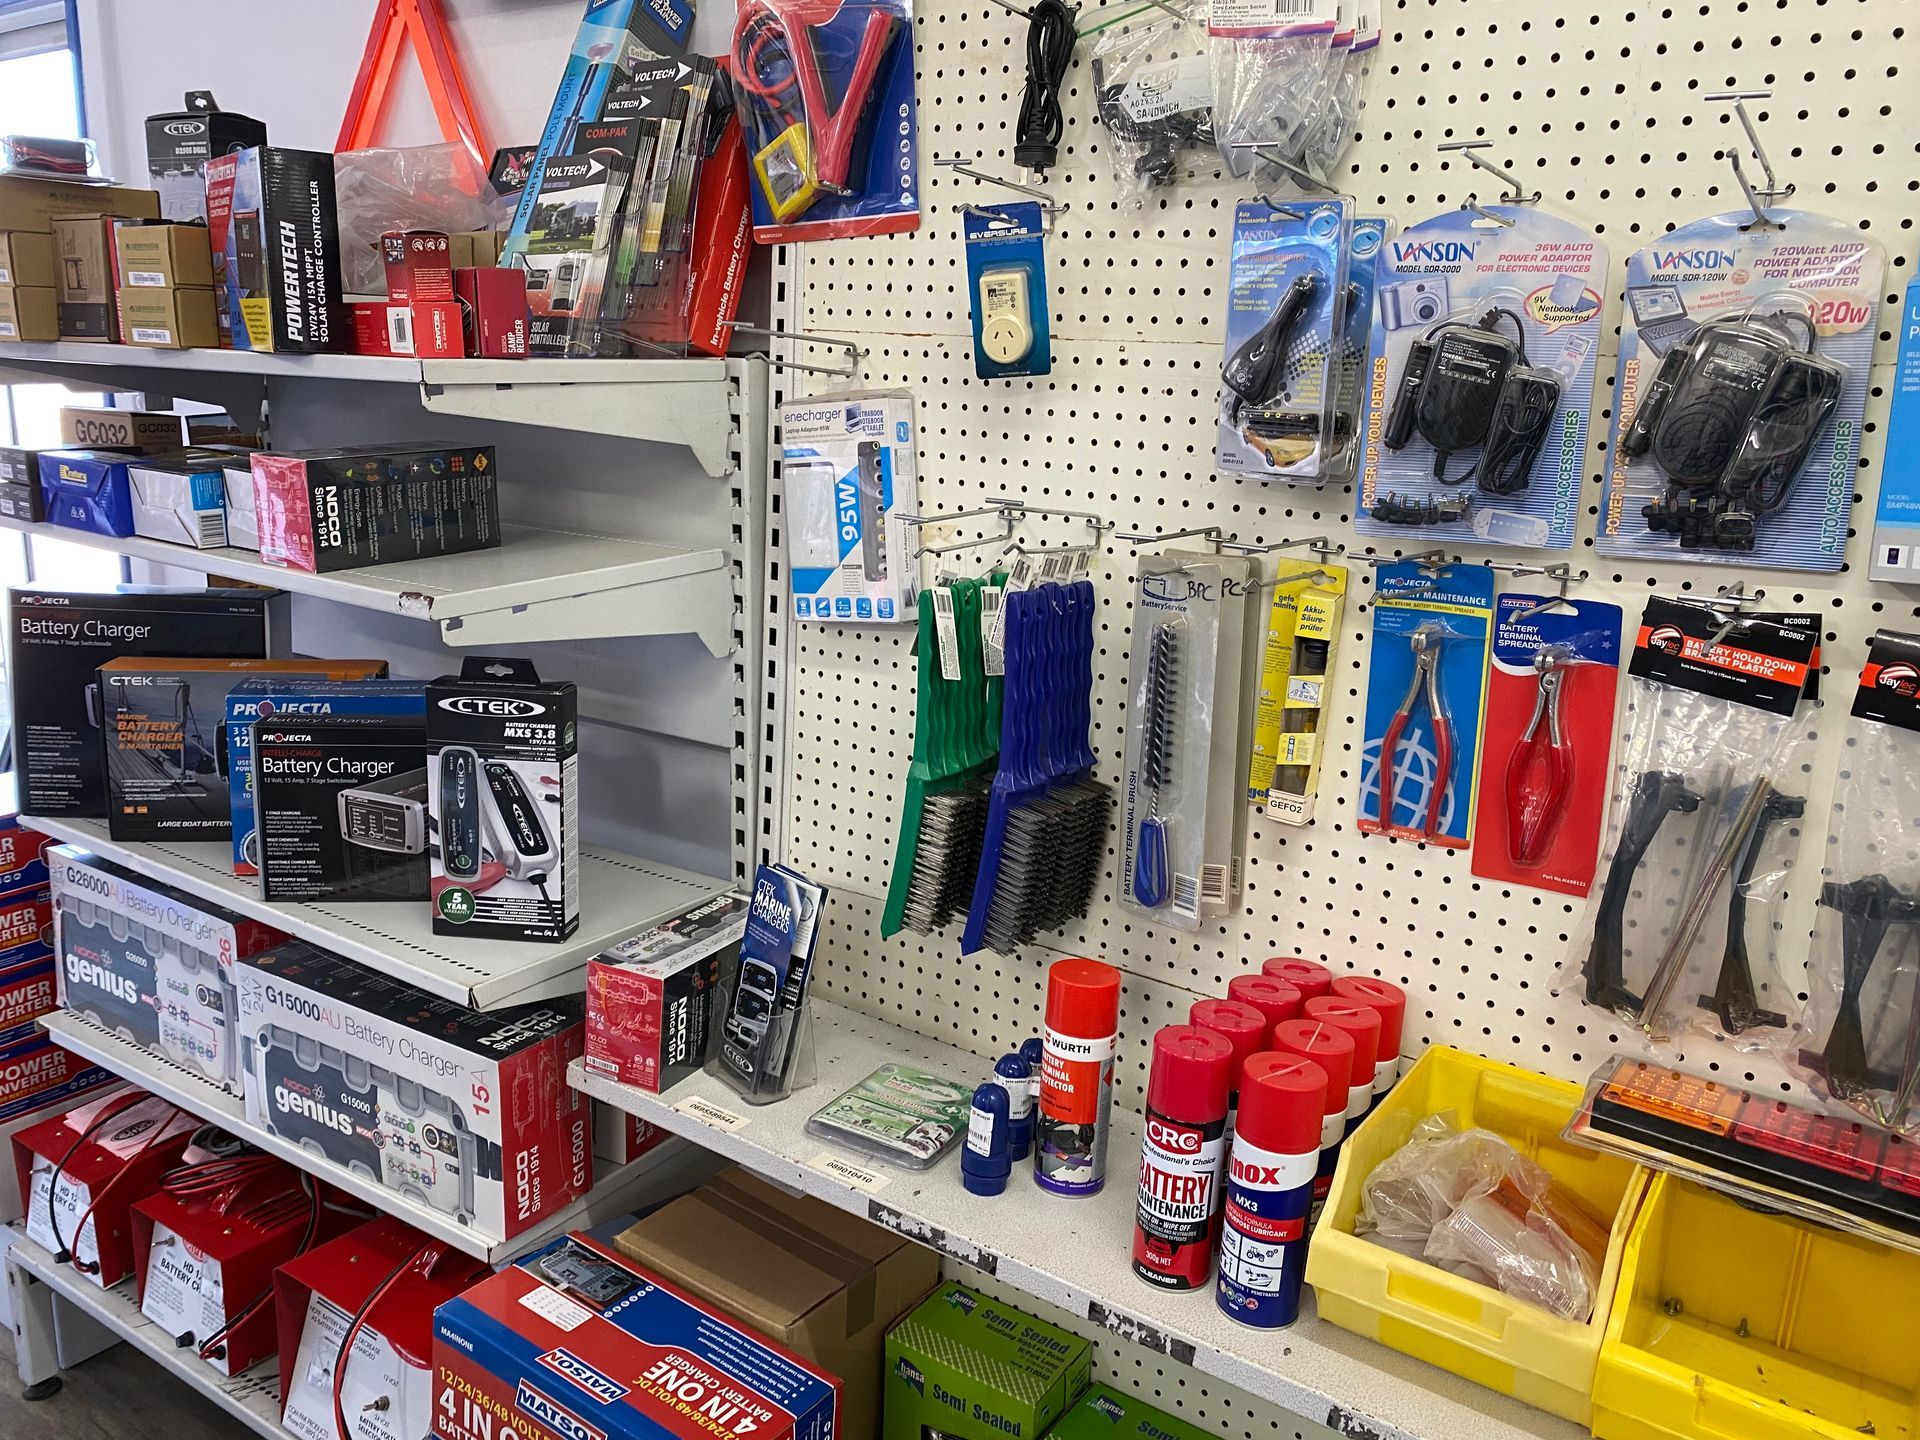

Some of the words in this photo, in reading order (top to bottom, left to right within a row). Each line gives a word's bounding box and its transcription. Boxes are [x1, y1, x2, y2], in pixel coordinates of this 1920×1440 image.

[634, 68, 675, 82] VOLTECH
[608, 100, 639, 110] VOLTECH
[1136, 101, 1180, 119] SANDWICH
[171, 123, 196, 134] CTEK
[586, 127, 627, 138] COM-PAK
[519, 177, 536, 220] SOLAR
[533, 146, 550, 180] PANEL
[548, 113, 561, 140] POLE
[558, 71, 577, 111] MOUNT
[546, 164, 587, 177] VOLTECH
[309, 180, 324, 256] CONTROLLER
[969, 227, 1028, 240] EVERSURE
[1393, 241, 1475, 263] VANSON
[1535, 244, 1562, 252] 36W
[1564, 243, 1594, 252] AUTO
[1772, 246, 1829, 257] 120Watt
[1830, 243, 1865, 255] AUTO
[303, 247, 314, 278] MPPT
[1499, 254, 1538, 263] POWER
[1541, 254, 1593, 263] ADAPTOR
[1653, 249, 1736, 270] VANSON
[1754, 257, 1801, 268] POWER
[709, 293, 728, 347] In-vehicle
[723, 250, 740, 290] Battery
[732, 205, 750, 250] Charger
[1395, 265, 1422, 273] MODEL
[1424, 265, 1462, 273] SDR-3000
[1476, 265, 1494, 273] FOR
[1496, 265, 1550, 273] ELECTRONIC
[1551, 265, 1591, 273] DEVICES
[1650, 274, 1680, 283] MODEL
[1682, 273, 1728, 282] SDR-120W
[1763, 269, 1788, 279] FOR
[279, 220, 304, 342] POWERTECH
[303, 279, 315, 300] 15A
[313, 257, 326, 304] CHARGE
[1788, 277, 1860, 289] COMPUTER
[1534, 295, 1546, 304] 9V
[1538, 304, 1575, 313] Netbook
[305, 301, 320, 341] 12V/24V
[318, 306, 329, 342] SOLAR
[530, 321, 550, 333] SOLAR
[1542, 313, 1591, 323] Supported
[516, 319, 525, 354] REDUCER
[1370, 357, 1388, 409] DEVICES
[784, 410, 842, 422] enecharger
[75, 418, 129, 446] GC032
[138, 423, 177, 433] GC032
[1367, 411, 1383, 447] YOUR
[1365, 445, 1380, 464] UP
[1556, 409, 1580, 498] ACCESSORIES
[1606, 490, 1626, 535] POWER
[1618, 358, 1641, 432] COMPUTER
[1826, 419, 1853, 514] ACCESSORIES
[1361, 466, 1378, 509] POWER
[314, 487, 325, 519] Since
[838, 483, 858, 541] 95W
[325, 485, 342, 547] NOCO
[1552, 497, 1570, 535] AUTO
[317, 520, 330, 547] 1914
[1820, 513, 1840, 554] AUTO
[1384, 578, 1431, 587] PROJECTA
[20, 596, 70, 605] PROJECTA
[1141, 600, 1187, 612] BatteryService
[1278, 595, 1295, 603] gefo
[1423, 591, 1487, 606] MAINTENANCE
[1502, 600, 1537, 608] MATSON
[1301, 613, 1326, 623] Säure-
[1303, 605, 1326, 614] Akku-
[20, 618, 79, 639] Battery
[84, 620, 150, 641] Charger
[1299, 623, 1324, 632] prüfer
[1499, 624, 1540, 633] BATTERY
[1784, 617, 1811, 625] BC0002
[1498, 632, 1543, 642] TERMINAL
[1650, 637, 1680, 651] Jaylec
[1779, 629, 1806, 641] BC0002
[1731, 659, 1775, 677] PLASTIC
[1733, 651, 1763, 665] HOLD
[1764, 658, 1796, 673] DOWN
[110, 676, 153, 686] CTEK
[1879, 673, 1917, 691] Jaylec
[457, 699, 521, 715] CTEK
[117, 722, 178, 731] BATTERY
[266, 716, 322, 725] Battery
[118, 732, 185, 742] CHARGER
[262, 733, 312, 742] PROJECTA
[503, 727, 532, 738] MXS
[534, 728, 556, 739] 3.8
[262, 758, 323, 777] Battery
[327, 758, 395, 777] Charger
[1128, 770, 1137, 804] BRUSH
[1126, 808, 1135, 854] TERMINAL
[1123, 854, 1133, 896] BATTERY
[757, 879, 777, 896] CTEK
[443, 907, 471, 917] WARRANTY
[446, 902, 468, 911] YEAR
[754, 891, 792, 917] MARINE
[127, 890, 164, 922] Battery
[166, 906, 213, 940] Charger
[752, 902, 791, 934] CHARGERS
[66, 953, 138, 1004] genius
[477, 1009, 554, 1047] NOCO
[492, 1031, 534, 1052] Since
[532, 1014, 567, 1038] 1914
[676, 996, 689, 1062] NOCO
[344, 1015, 395, 1055] Battery
[398, 1038, 460, 1078] Charger
[587, 1032, 607, 1046] no.co
[1052, 1038, 1091, 1054] WÜRTH
[274, 1085, 353, 1136] genius
[340, 1093, 371, 1114] G15000
[1149, 1120, 1199, 1151] CRC
[572, 1120, 585, 1187] G15000
[1192, 1156, 1217, 1166] Choice
[516, 1150, 531, 1221] NOCO
[1138, 1155, 1210, 1205] BATTERY
[1235, 1192, 1259, 1213] MX3
[1163, 1221, 1179, 1231] WIPE
[1243, 1215, 1273, 1231] FORMULA
[1250, 1225, 1288, 1238] LUBRICANT
[159, 1257, 192, 1287] BATTERY
[1160, 1257, 1172, 1267] NET
[1138, 1265, 1178, 1285] CLEANER
[951, 1291, 978, 1309] hansa
[440, 1326, 474, 1352] MA4INONE
[982, 1308, 1019, 1332] Semi
[1020, 1326, 1072, 1355] Sealed
[549, 1351, 623, 1399] MATSON
[664, 1352, 720, 1388] CHARGER
[900, 1362, 924, 1385] hansa
[642, 1360, 705, 1402] ONE
[439, 1366, 508, 1422] 12/24/36/48
[439, 1387, 457, 1419] 4
[649, 1386, 678, 1408] VOLT
[698, 1394, 740, 1425] IN
[720, 1388, 773, 1423] BATTERY
[933, 1383, 967, 1414] Semi
[972, 1403, 1022, 1438] Sealed
[1097, 1396, 1125, 1418] hansa
